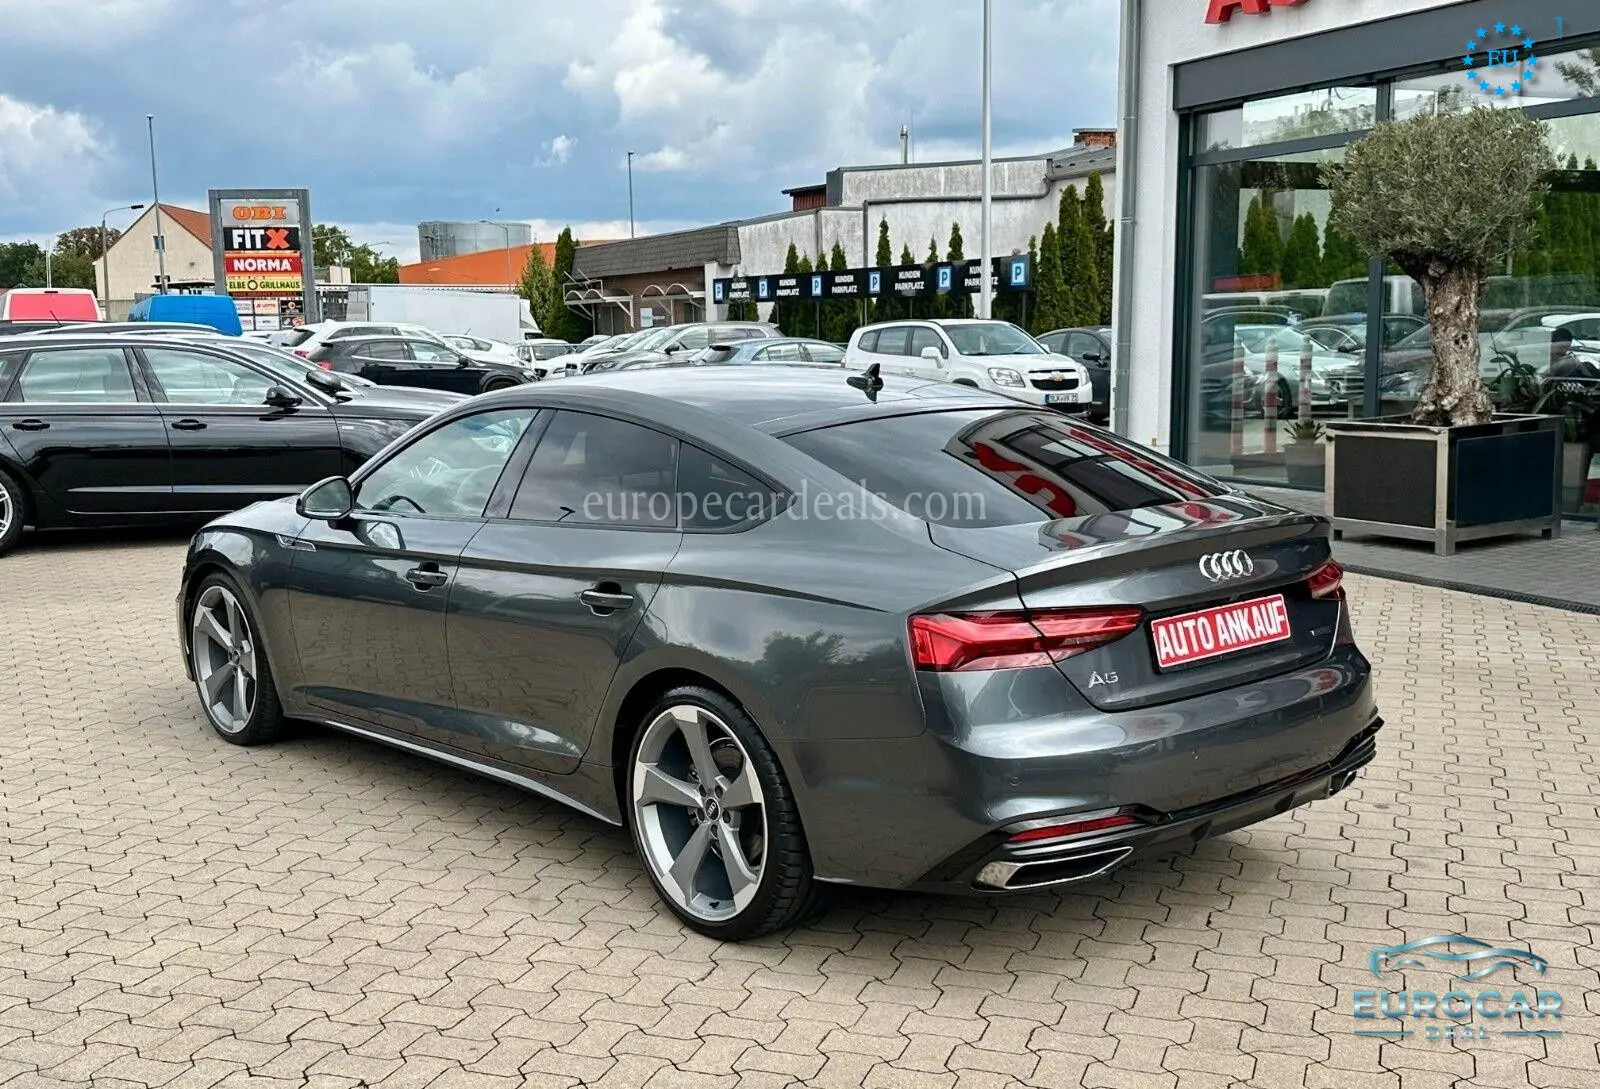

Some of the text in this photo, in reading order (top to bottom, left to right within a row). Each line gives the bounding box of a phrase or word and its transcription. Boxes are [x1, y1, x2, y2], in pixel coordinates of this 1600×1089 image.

[233, 206, 286, 219] OBI
[233, 258, 293, 272] NORMA
[229, 280, 300, 289] ELBE GRILLHAUS
[831, 284, 858, 294] PARKPLATZ
[894, 280, 925, 290] PARKPLATZ
[728, 290, 750, 298] PARKPLATZ
[776, 288, 800, 296] PARKPLATZ
[1157, 601, 1286, 662] AUTO ANKAUF
[1087, 670, 1119, 689] A5
